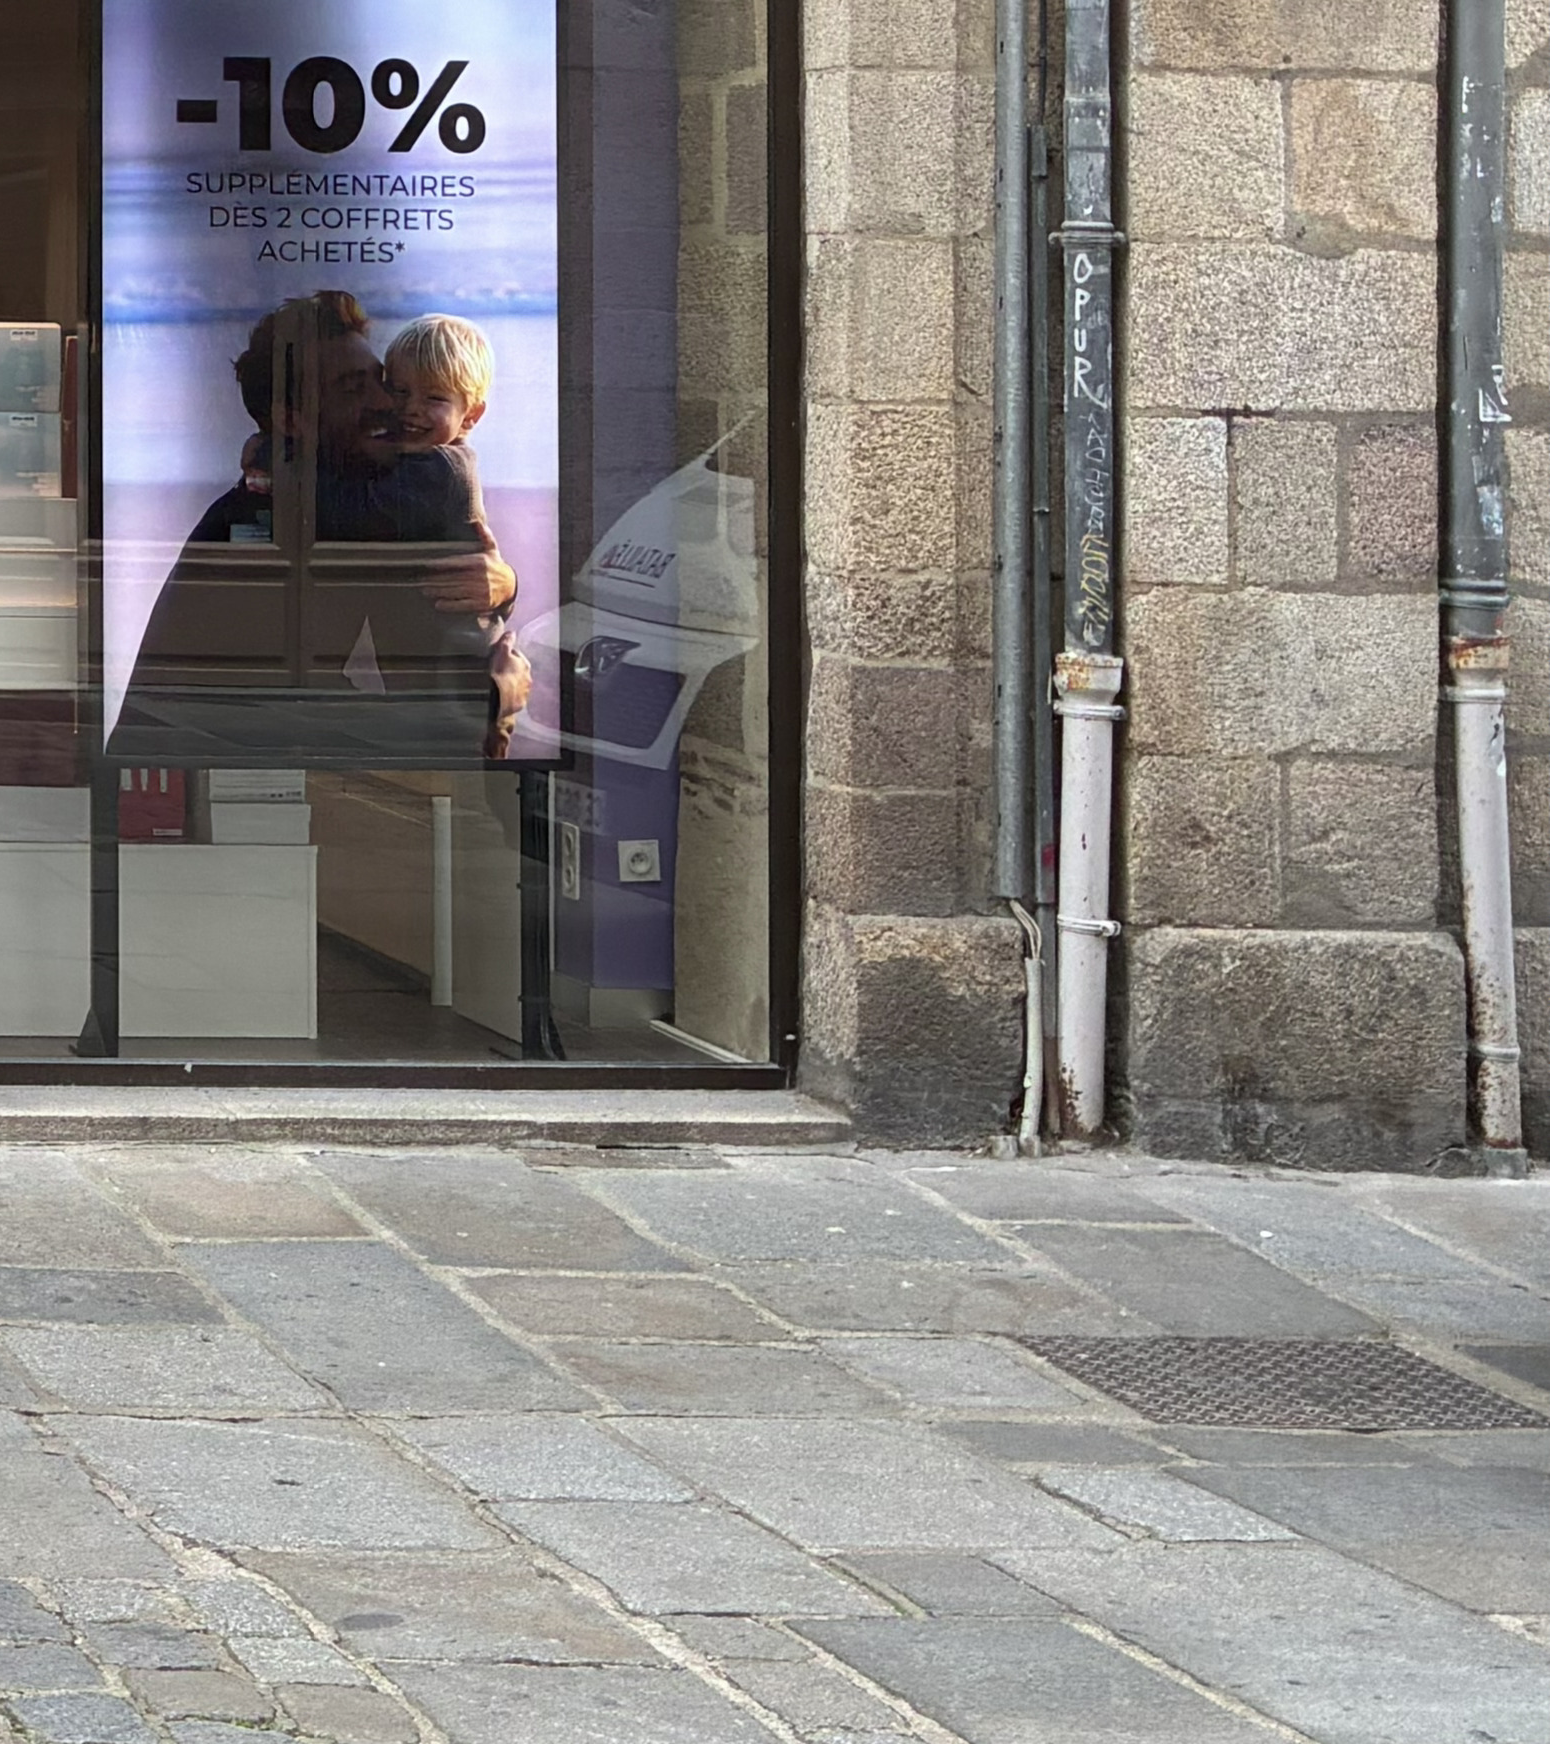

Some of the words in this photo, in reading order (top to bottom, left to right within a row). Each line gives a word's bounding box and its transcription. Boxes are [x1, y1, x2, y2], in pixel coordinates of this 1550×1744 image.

[175, 56, 487, 155] -10%
[186, 167, 476, 199] SUPPLÉMENTAIRES
[209, 200, 268, 231] DÈS
[276, 205, 293, 231] 2
[299, 204, 455, 232] COFFRETS
